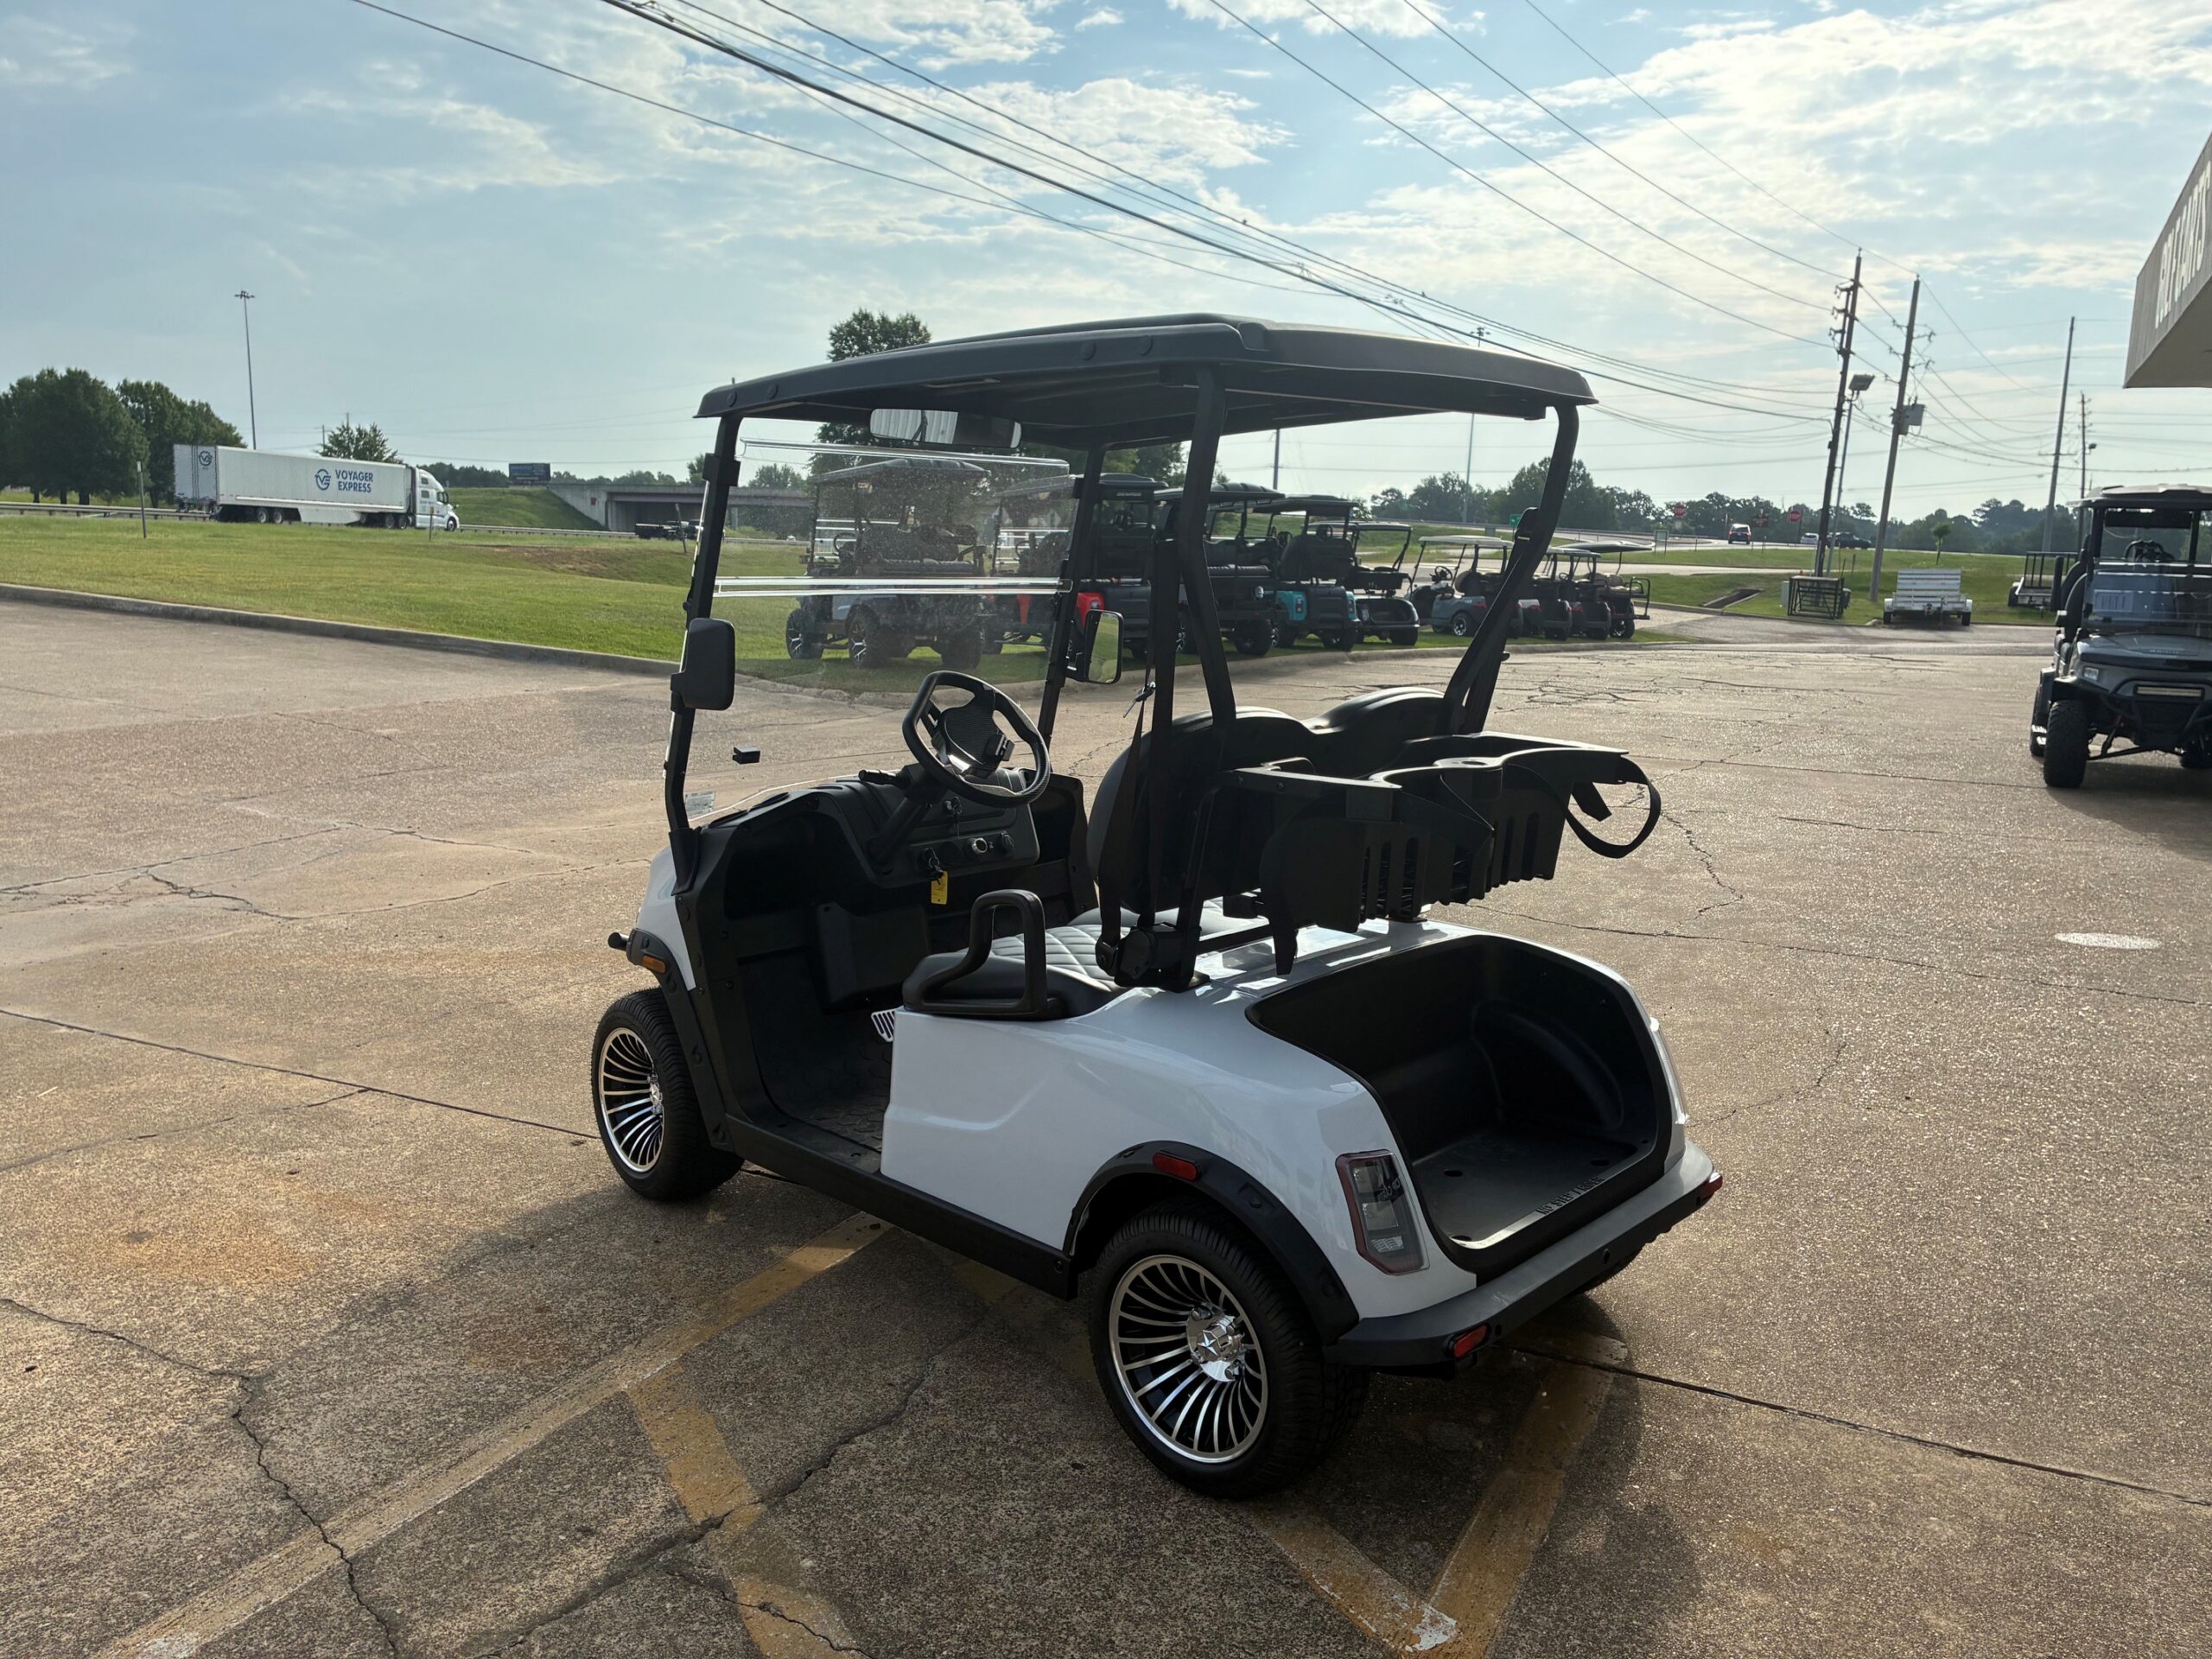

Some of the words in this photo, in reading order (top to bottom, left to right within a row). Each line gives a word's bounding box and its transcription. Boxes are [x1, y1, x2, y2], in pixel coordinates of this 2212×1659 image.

[2174, 160, 2210, 302] CARTS
[335, 469, 373, 482] VOYAGER
[338, 480, 372, 493] EXPRESS
[1535, 1205, 1554, 1215] NO
[1551, 1192, 1574, 1207] STEP
